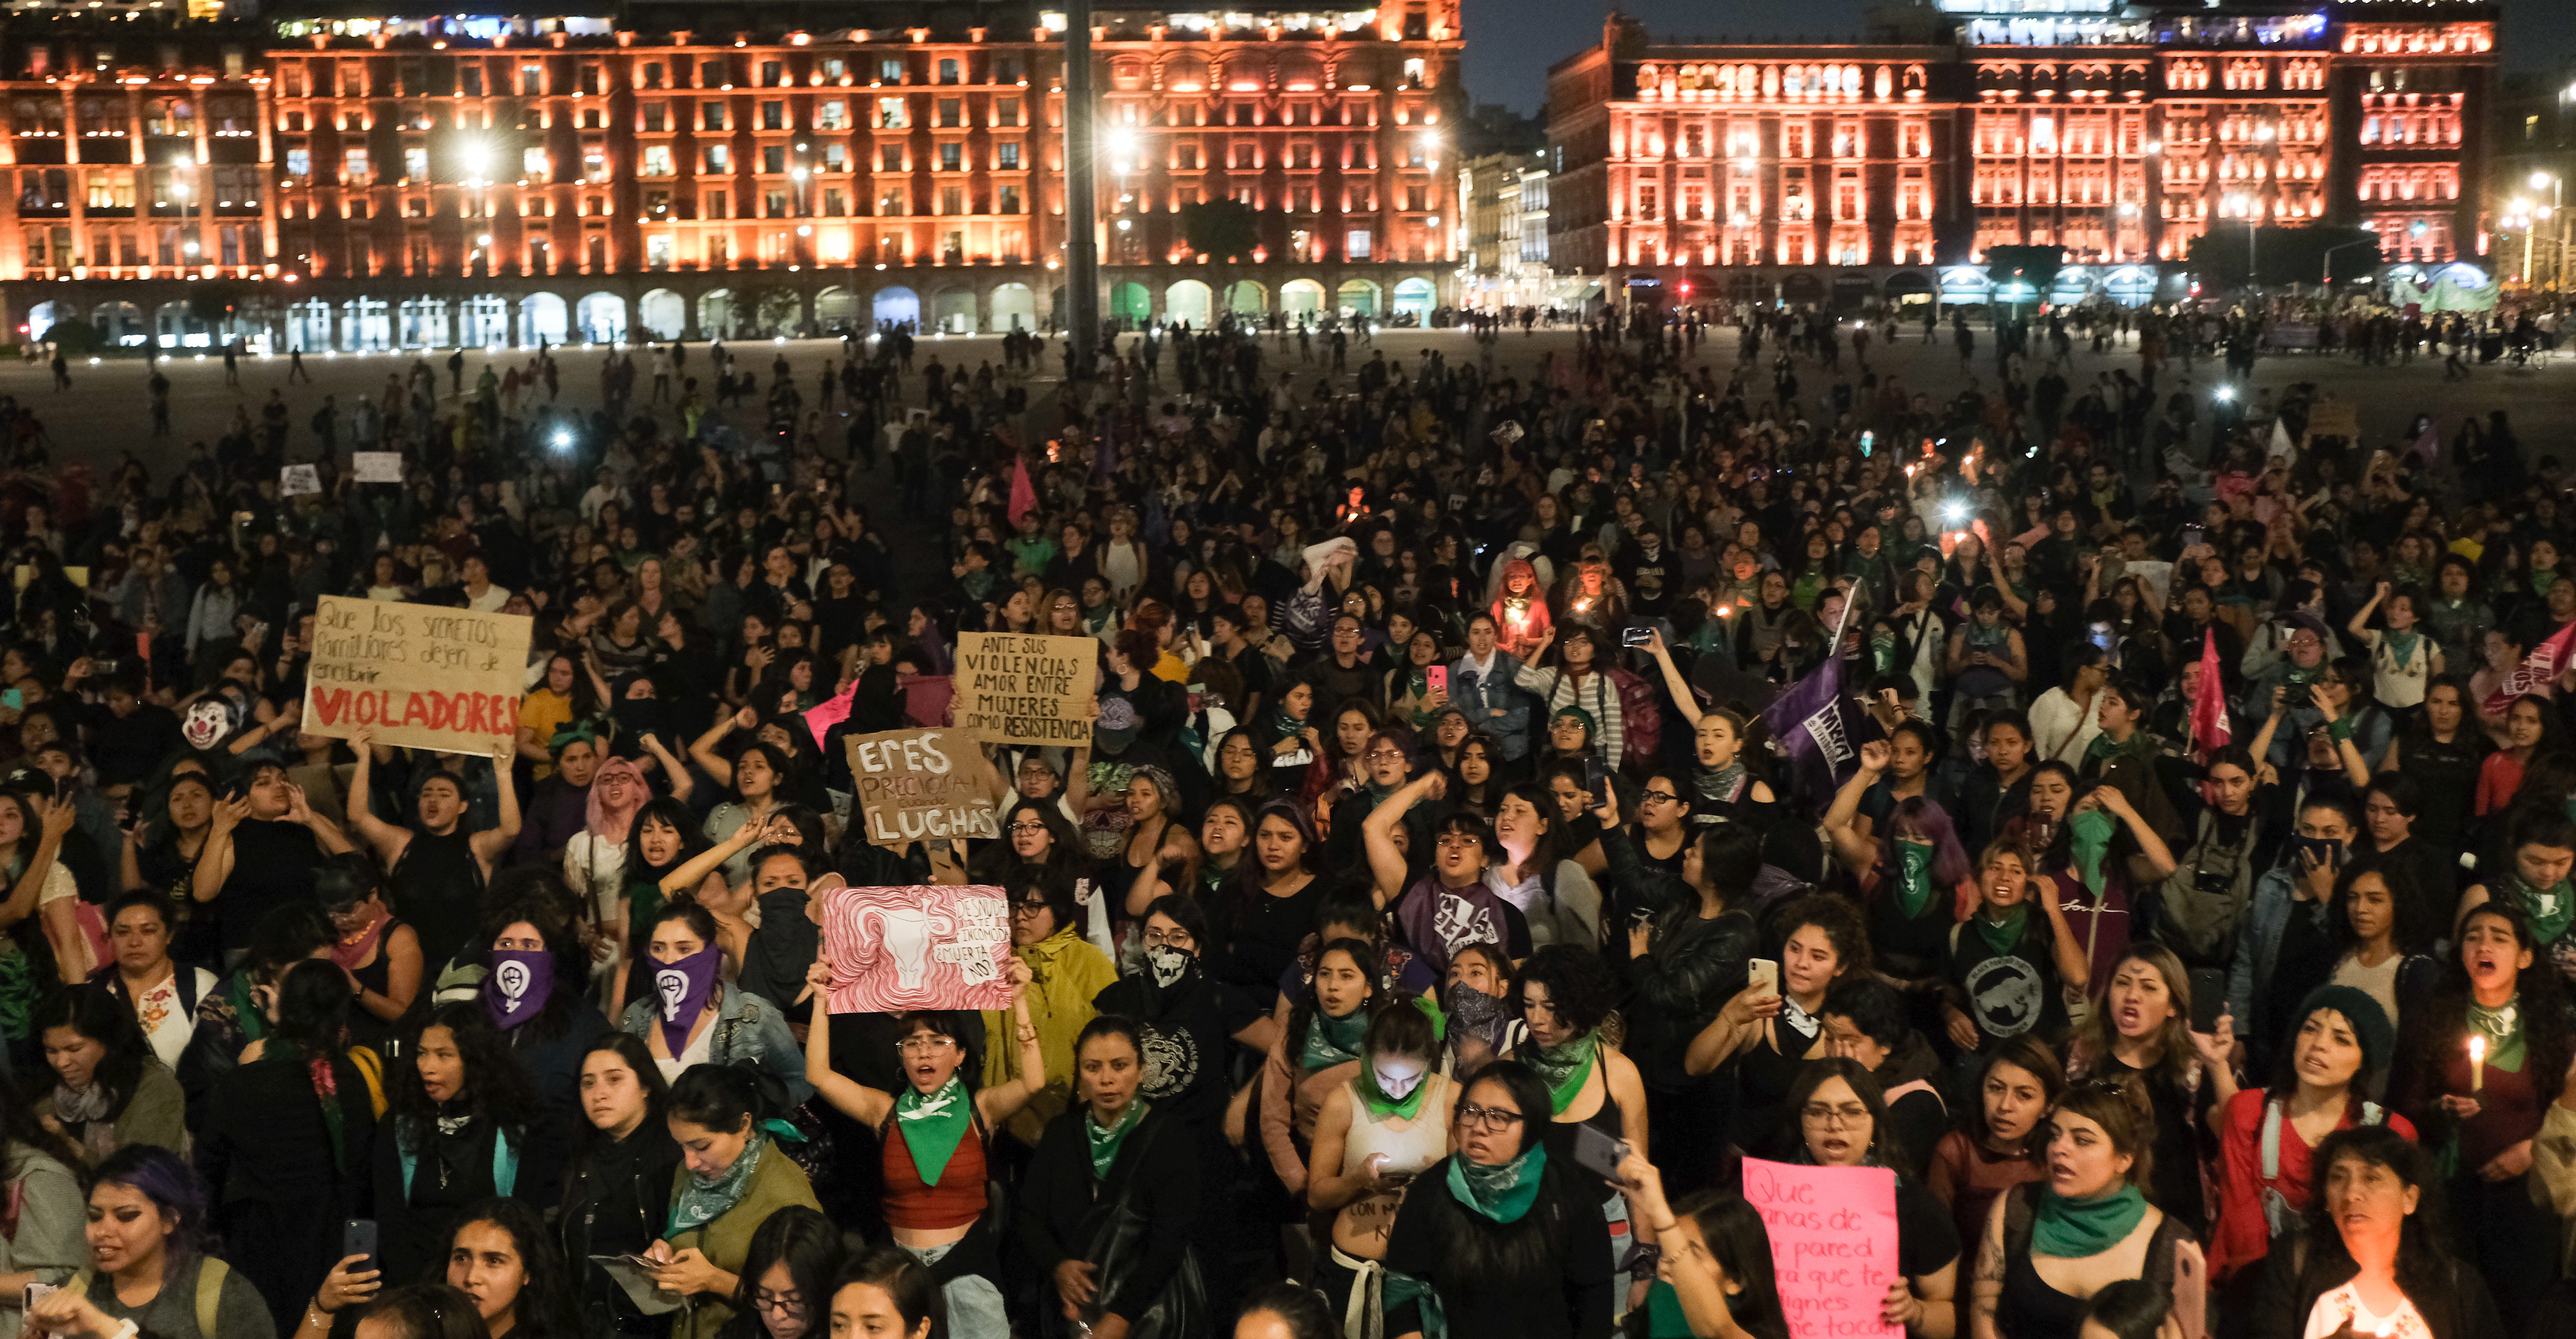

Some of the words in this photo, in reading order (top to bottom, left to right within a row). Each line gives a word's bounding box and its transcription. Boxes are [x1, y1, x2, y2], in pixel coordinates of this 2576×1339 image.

[317, 601, 356, 630] Que
[371, 606, 404, 636] los
[420, 642, 469, 670] dejen
[480, 652, 499, 671] de
[981, 637, 1016, 653] ANTE
[1022, 638, 1046, 654] SUS
[965, 654, 1078, 676] VIOLENCIAS
[973, 673, 1017, 693] AMOR
[1027, 676, 1073, 696] ENTRE
[312, 686, 519, 735] VIOLADORES
[978, 694, 1059, 717] MUJERES
[966, 713, 1000, 731] COMO
[1004, 716, 1090, 740] RESISTENCIA
[873, 806, 1000, 840] LUCHAS
[955, 899, 1008, 919] DESNUDA
[977, 918, 990, 926] TE
[961, 928, 1010, 942] INCOMODA
[936, 944, 989, 961] ¿MUERTA
[967, 959, 994, 982] NO?
[1747, 1166, 1814, 1204] Que
[1350, 1202, 1376, 1216] CON
[1760, 1207, 1821, 1230] anas
[1830, 1207, 1861, 1231] de
[1795, 1237, 1873, 1268] pared
[1809, 1268, 1855, 1294] que
[1862, 1264, 1888, 1285] te
